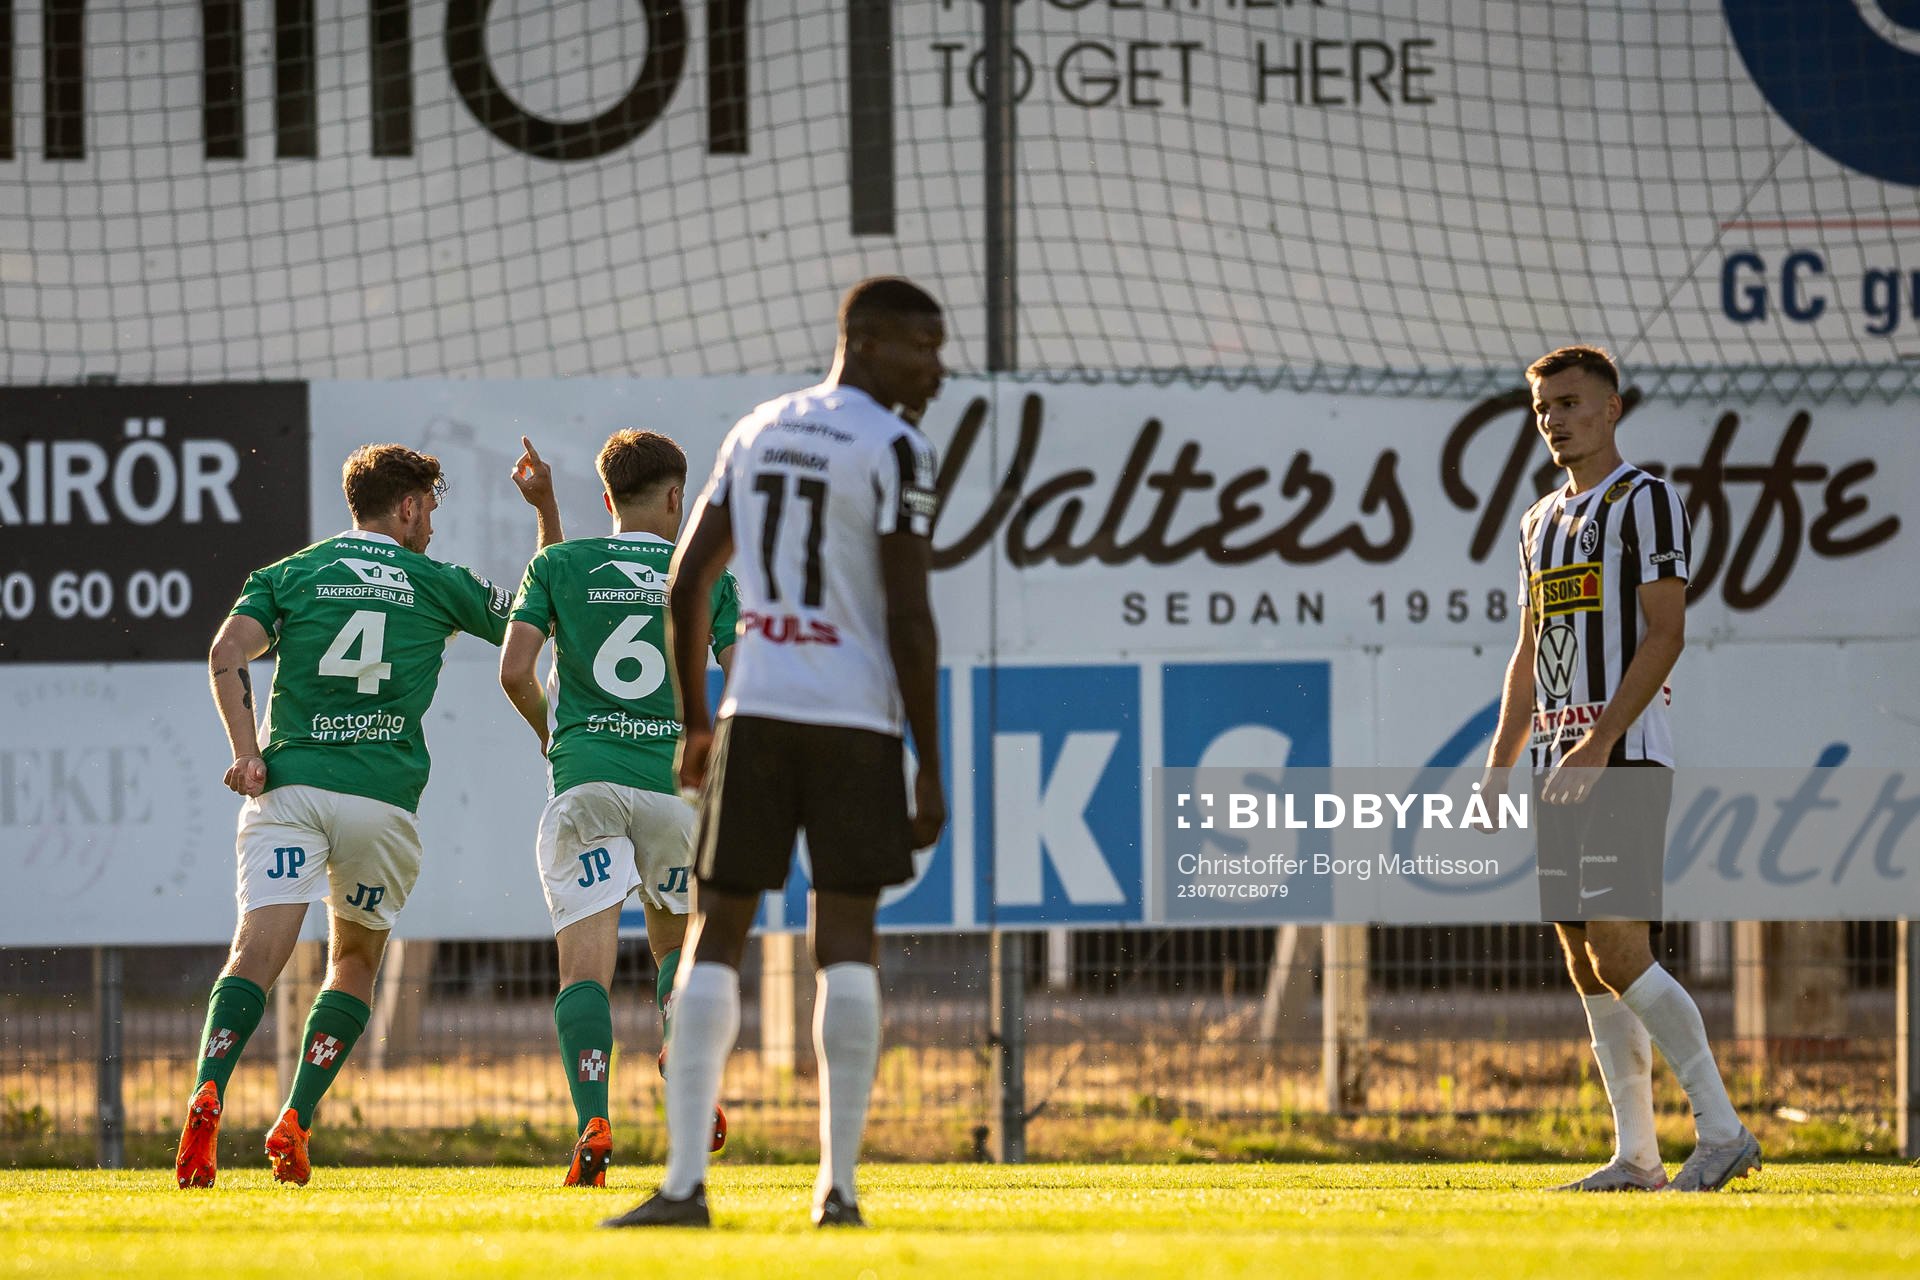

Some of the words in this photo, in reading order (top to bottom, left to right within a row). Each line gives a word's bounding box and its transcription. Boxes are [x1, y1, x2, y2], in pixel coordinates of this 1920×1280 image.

[929, 41, 1033, 107] TO
[1057, 40, 1202, 107] GET
[1256, 39, 1436, 107] HERE
[1720, 249, 1826, 324] GC
[1440, 384, 1902, 613] Kffe
[607, 543, 669, 554] KARLIN
[753, 473, 829, 609] 11
[0, 569, 35, 620] 0
[49, 569, 113, 619] 60
[127, 568, 192, 619] 00
[316, 586, 396, 601] TAKPROFFSEN
[398, 592, 415, 604] AB
[587, 590, 670, 605] TAKPROFFSEN
[1122, 591, 1325, 627] SEDAN
[1369, 589, 1508, 625] 1958
[1541, 577, 1582, 603] SSONS
[740, 609, 844, 646] PULS
[318, 609, 392, 695] 4
[592, 614, 666, 700] 6
[311, 709, 406, 734] factoring
[267, 846, 306, 879] JP
[578, 847, 611, 888] JP
[346, 882, 385, 913] JP
